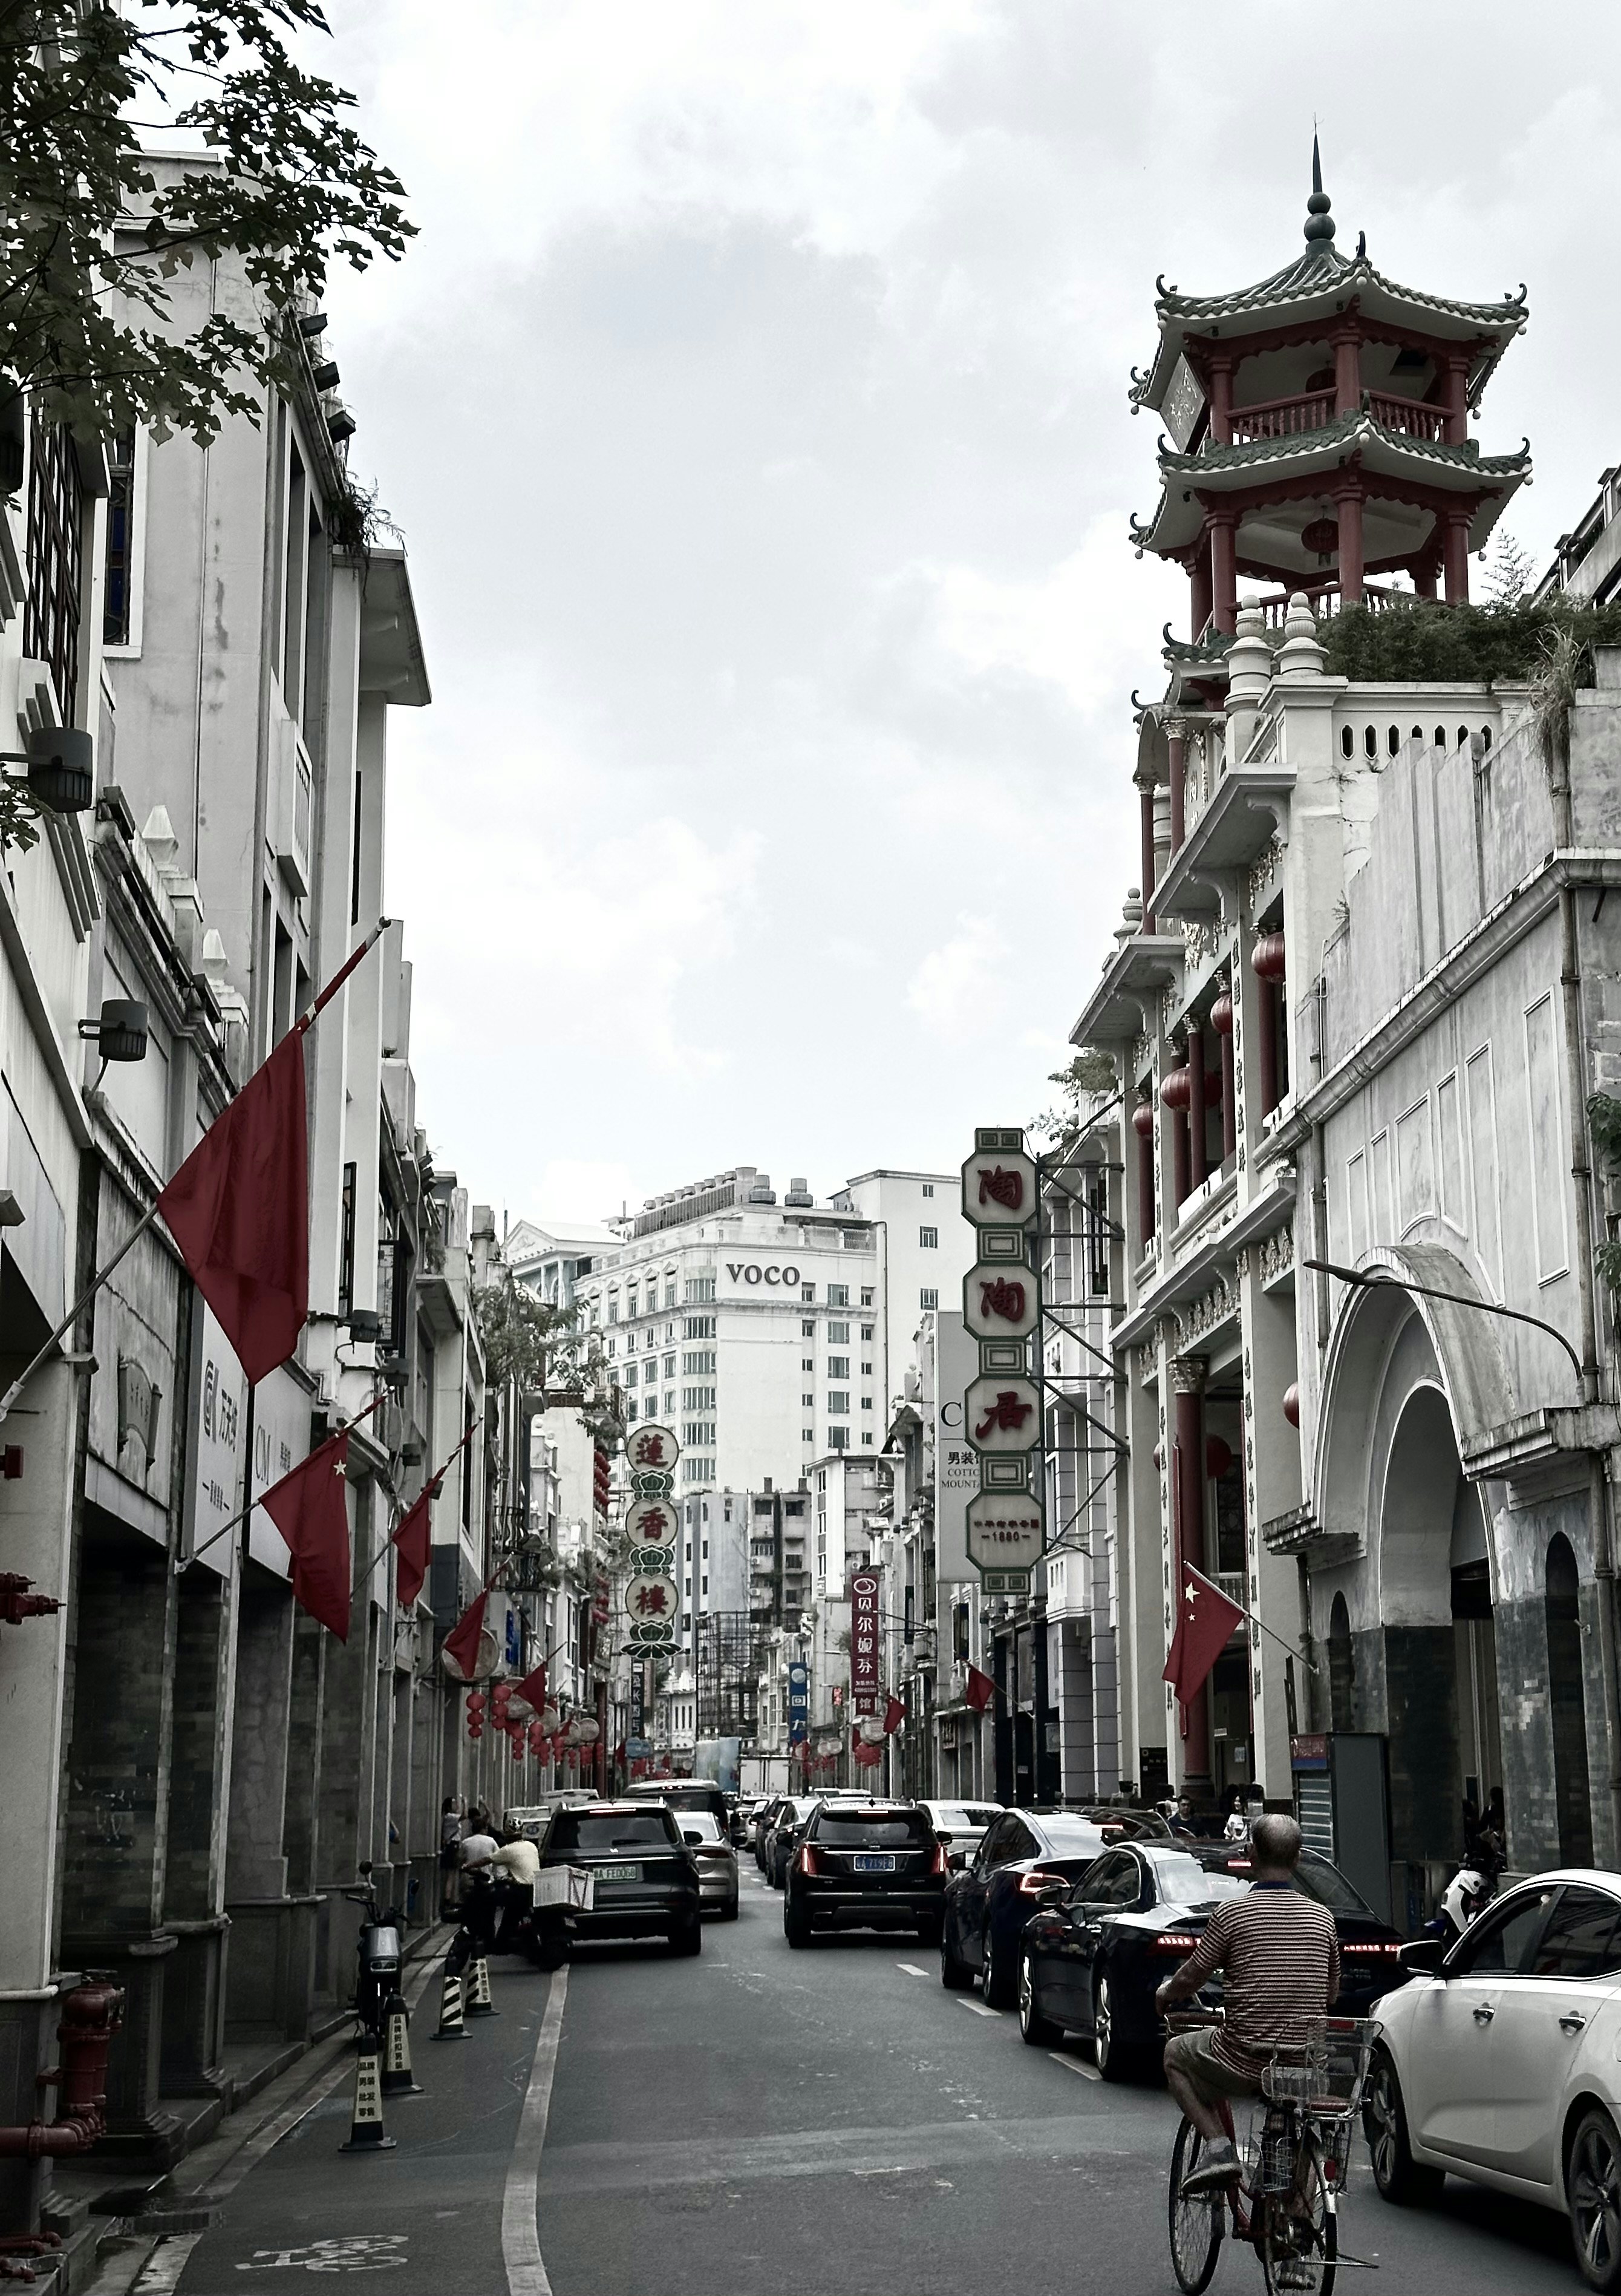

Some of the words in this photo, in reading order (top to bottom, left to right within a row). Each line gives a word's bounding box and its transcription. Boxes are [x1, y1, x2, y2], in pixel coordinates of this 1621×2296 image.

[975, 1165, 1032, 1439] 陶陶居
[941, 1401, 963, 1427] C
[948, 1451, 979, 1465] 男装
[857, 1597, 873, 1673] 贝尔妮芬
